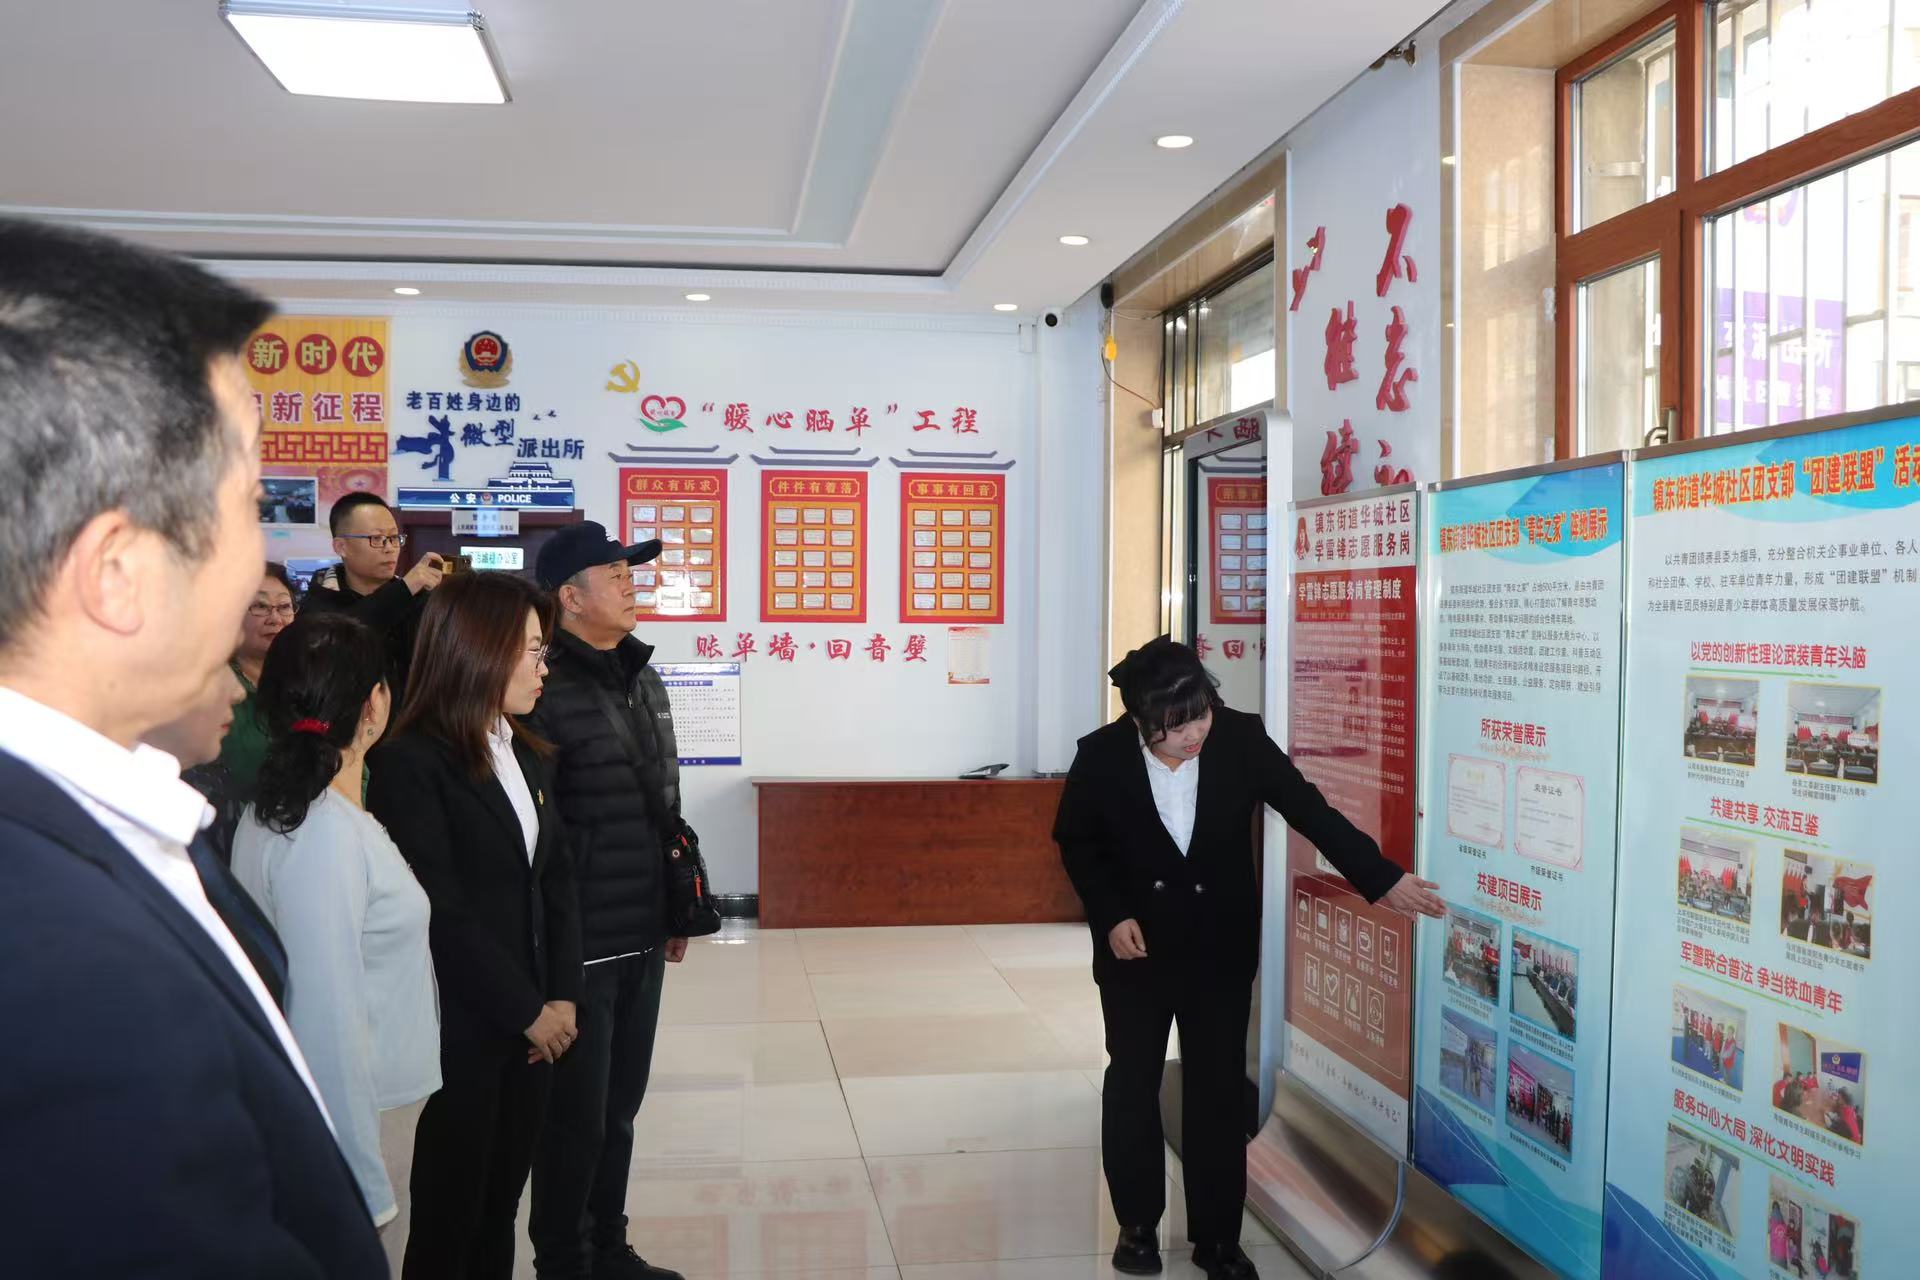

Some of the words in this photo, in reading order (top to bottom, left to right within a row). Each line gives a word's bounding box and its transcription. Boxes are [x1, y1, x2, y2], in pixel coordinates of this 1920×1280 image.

[252, 338, 378, 373] 新时代
[253, 392, 382, 422] 新征程
[406, 390, 521, 412] 老百姓身边的
[460, 418, 515, 447] 微型
[702, 402, 980, 436] “暖心晒单”工程
[517, 438, 585, 460] 派出所
[450, 492, 477, 504] 公安
[497, 493, 532, 504] POLICE
[636, 478, 713, 493] 群众有诉求
[777, 480, 853, 495] 件件有着落
[917, 482, 992, 497] 事事有回音
[1315, 499, 1410, 534] 镇东街道华城社区
[1315, 530, 1410, 562] 学雷锋志愿服务岗
[1298, 577, 1402, 601] 学雷锋志愿服务岗管理制度
[696, 632, 927, 663] 账单墙·回音壁
[1691, 640, 1866, 669] 以党的创新性理论武装青年头脑
[1481, 718, 1546, 747] 所获荣誉展示
[1710, 796, 1759, 825] 共建共享
[1763, 806, 1819, 837] 交流互鉴
[1477, 872, 1542, 911] 共建项目展示
[1680, 940, 1753, 985] 军警联合普法
[1757, 967, 1843, 1014] 争当铁血青年
[1673, 1088, 1747, 1142] 服务中心大局
[1749, 1124, 1836, 1187] 深化文明实践
